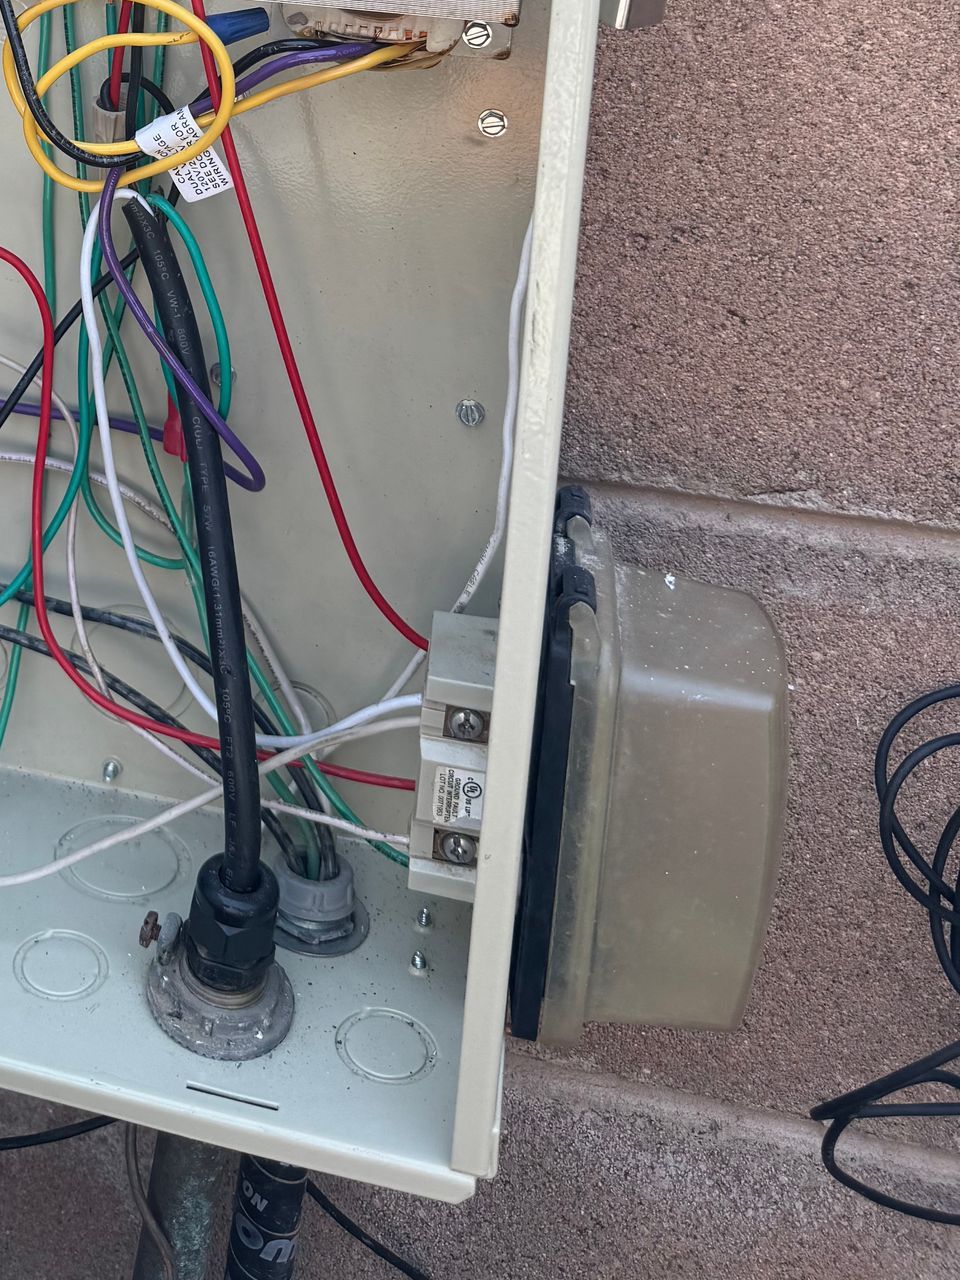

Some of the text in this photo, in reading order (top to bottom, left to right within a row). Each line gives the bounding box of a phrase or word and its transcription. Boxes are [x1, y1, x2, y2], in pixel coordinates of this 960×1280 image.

[171, 121, 188, 140] FOR
[203, 150, 228, 186] WIRING
[204, 170, 220, 188] SEE
[185, 169, 203, 195] DUAL
[453, 777, 461, 800] GROUND
